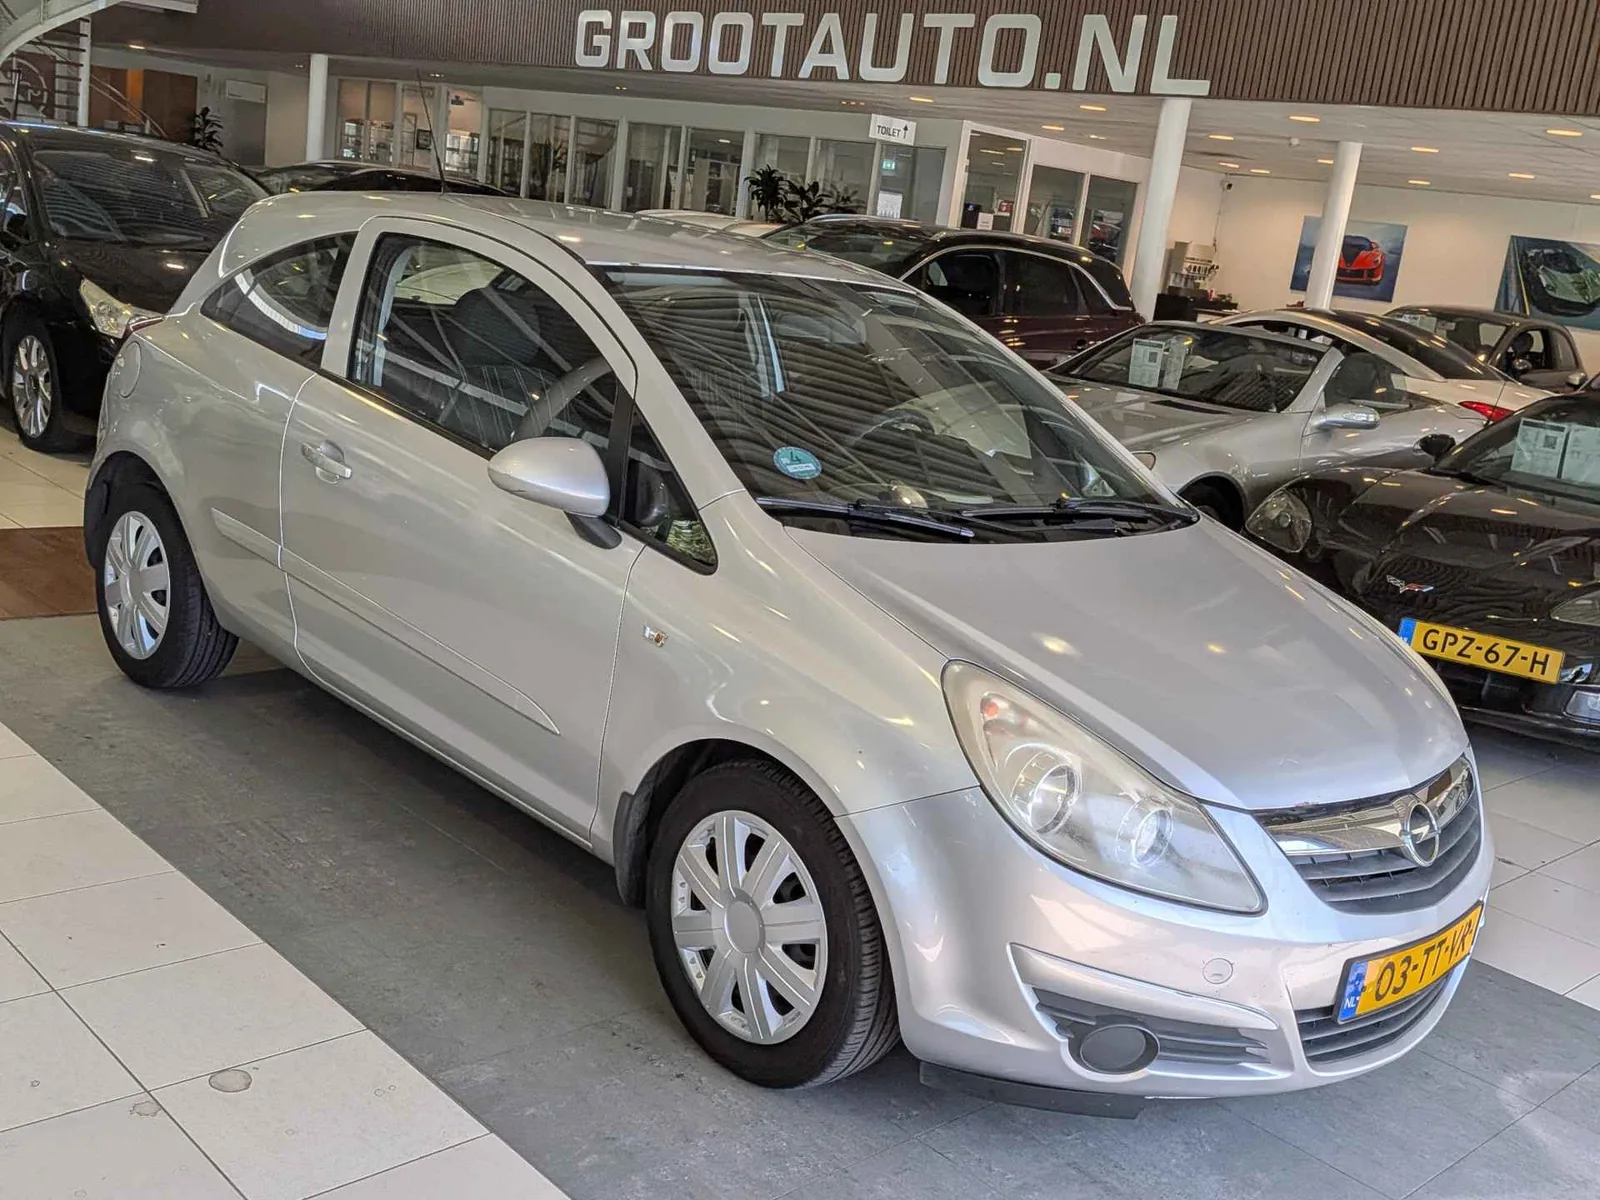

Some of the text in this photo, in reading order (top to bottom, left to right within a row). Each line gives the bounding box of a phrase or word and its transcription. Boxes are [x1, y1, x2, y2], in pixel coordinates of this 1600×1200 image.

[575, 10, 1210, 96] GROOTAUTO.NL
[876, 124, 901, 138] TOILET
[1422, 628, 1550, 676] GPZ-67-H
[1343, 996, 1357, 1009] NL
